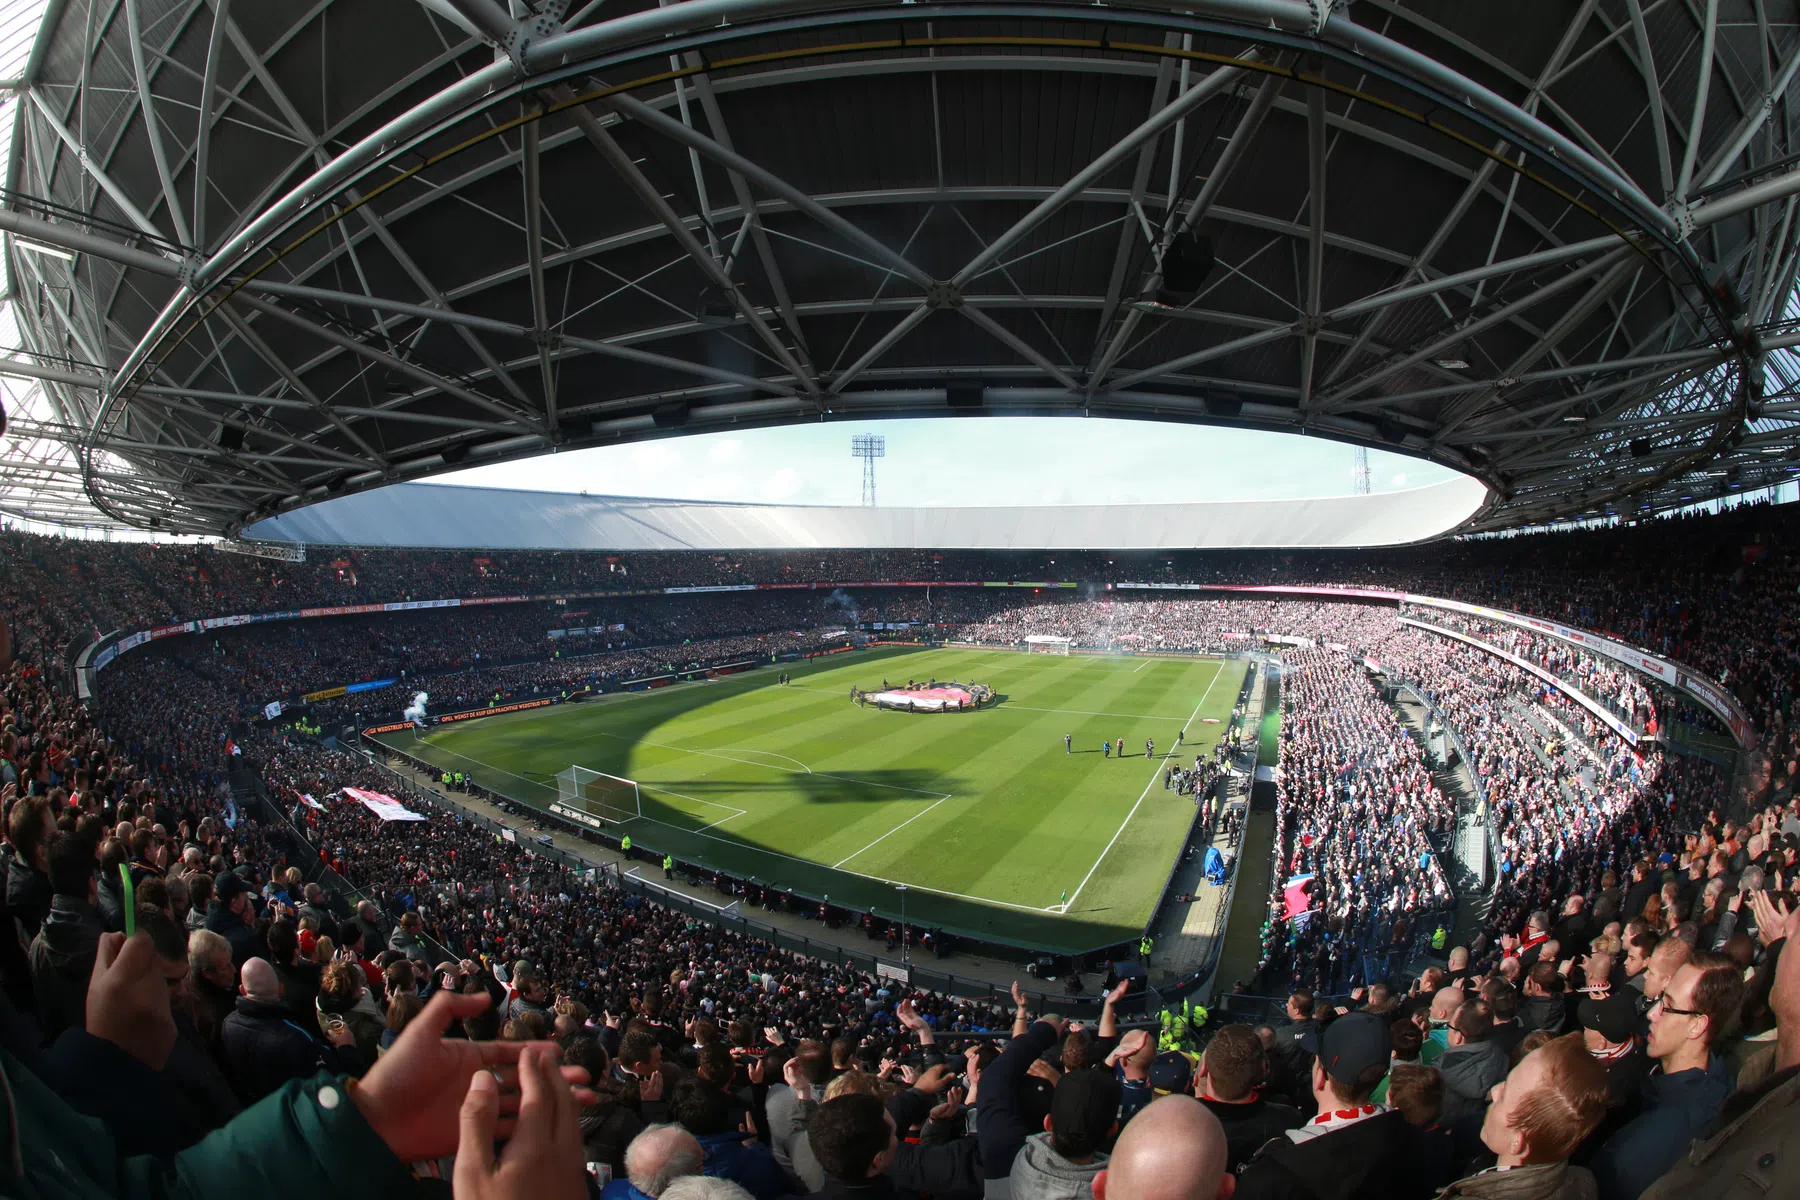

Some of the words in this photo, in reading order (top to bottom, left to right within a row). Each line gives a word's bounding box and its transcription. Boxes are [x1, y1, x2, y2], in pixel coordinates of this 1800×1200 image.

[441, 715, 454, 723] OPEL
[454, 713, 469, 721] WENST
[495, 705, 518, 713] PRACHTIGE
[519, 701, 541, 709] WEDSTRIJD
[377, 723, 403, 732] WEDSTRIJD
